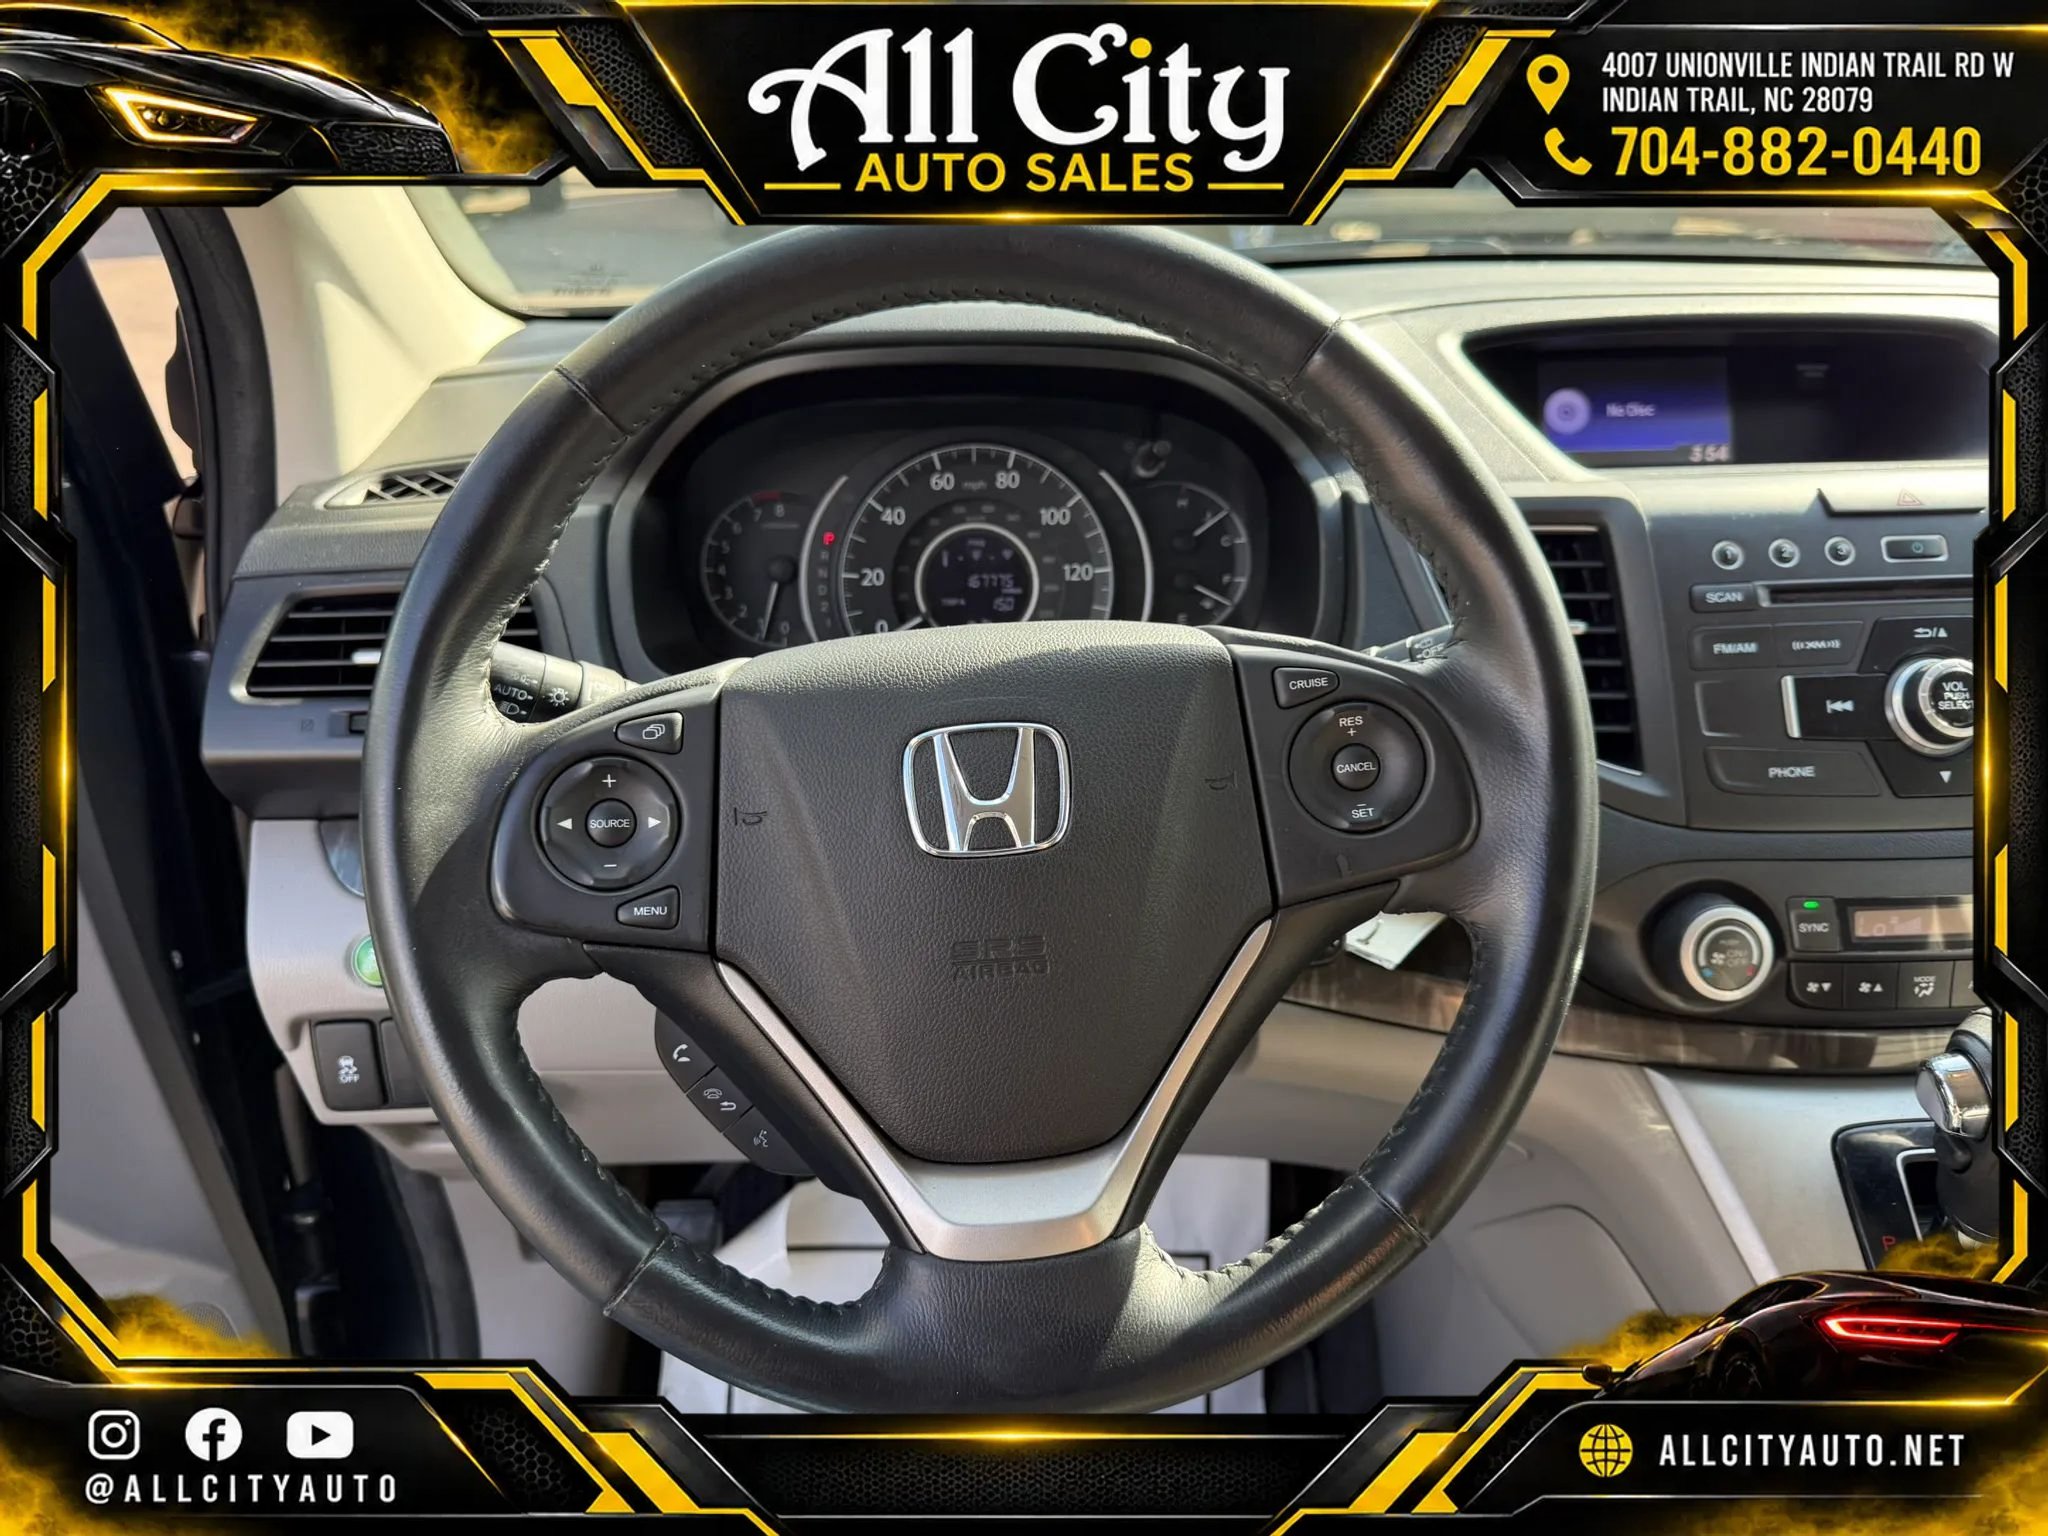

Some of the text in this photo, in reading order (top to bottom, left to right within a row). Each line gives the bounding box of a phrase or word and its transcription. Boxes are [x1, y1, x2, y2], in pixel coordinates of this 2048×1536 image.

[929, 472, 955, 490] 60
[995, 470, 1020, 489] 80
[880, 506, 906, 525] 40
[1040, 507, 1071, 525] 100
[822, 531, 836, 546] P
[860, 568, 885, 586] 20
[1063, 564, 1093, 581] 120
[1705, 591, 1744, 603] SCAN
[1713, 642, 1758, 655] FM/AM
[1289, 677, 1329, 690] CRUISE
[1942, 681, 1968, 692] VOL
[494, 684, 528, 700] AUTO
[1943, 691, 1970, 700] PUSH
[1339, 716, 1363, 727] RES
[1336, 761, 1376, 774] CANCEL
[1768, 766, 1816, 778] PHONE
[1351, 807, 1375, 819] SET
[589, 818, 630, 829] SOURCE
[633, 906, 668, 917] MENU
[1798, 922, 1829, 933] SYNC
[339, 1074, 360, 1084] OFF
[1882, 1236, 1896, 1250] P
